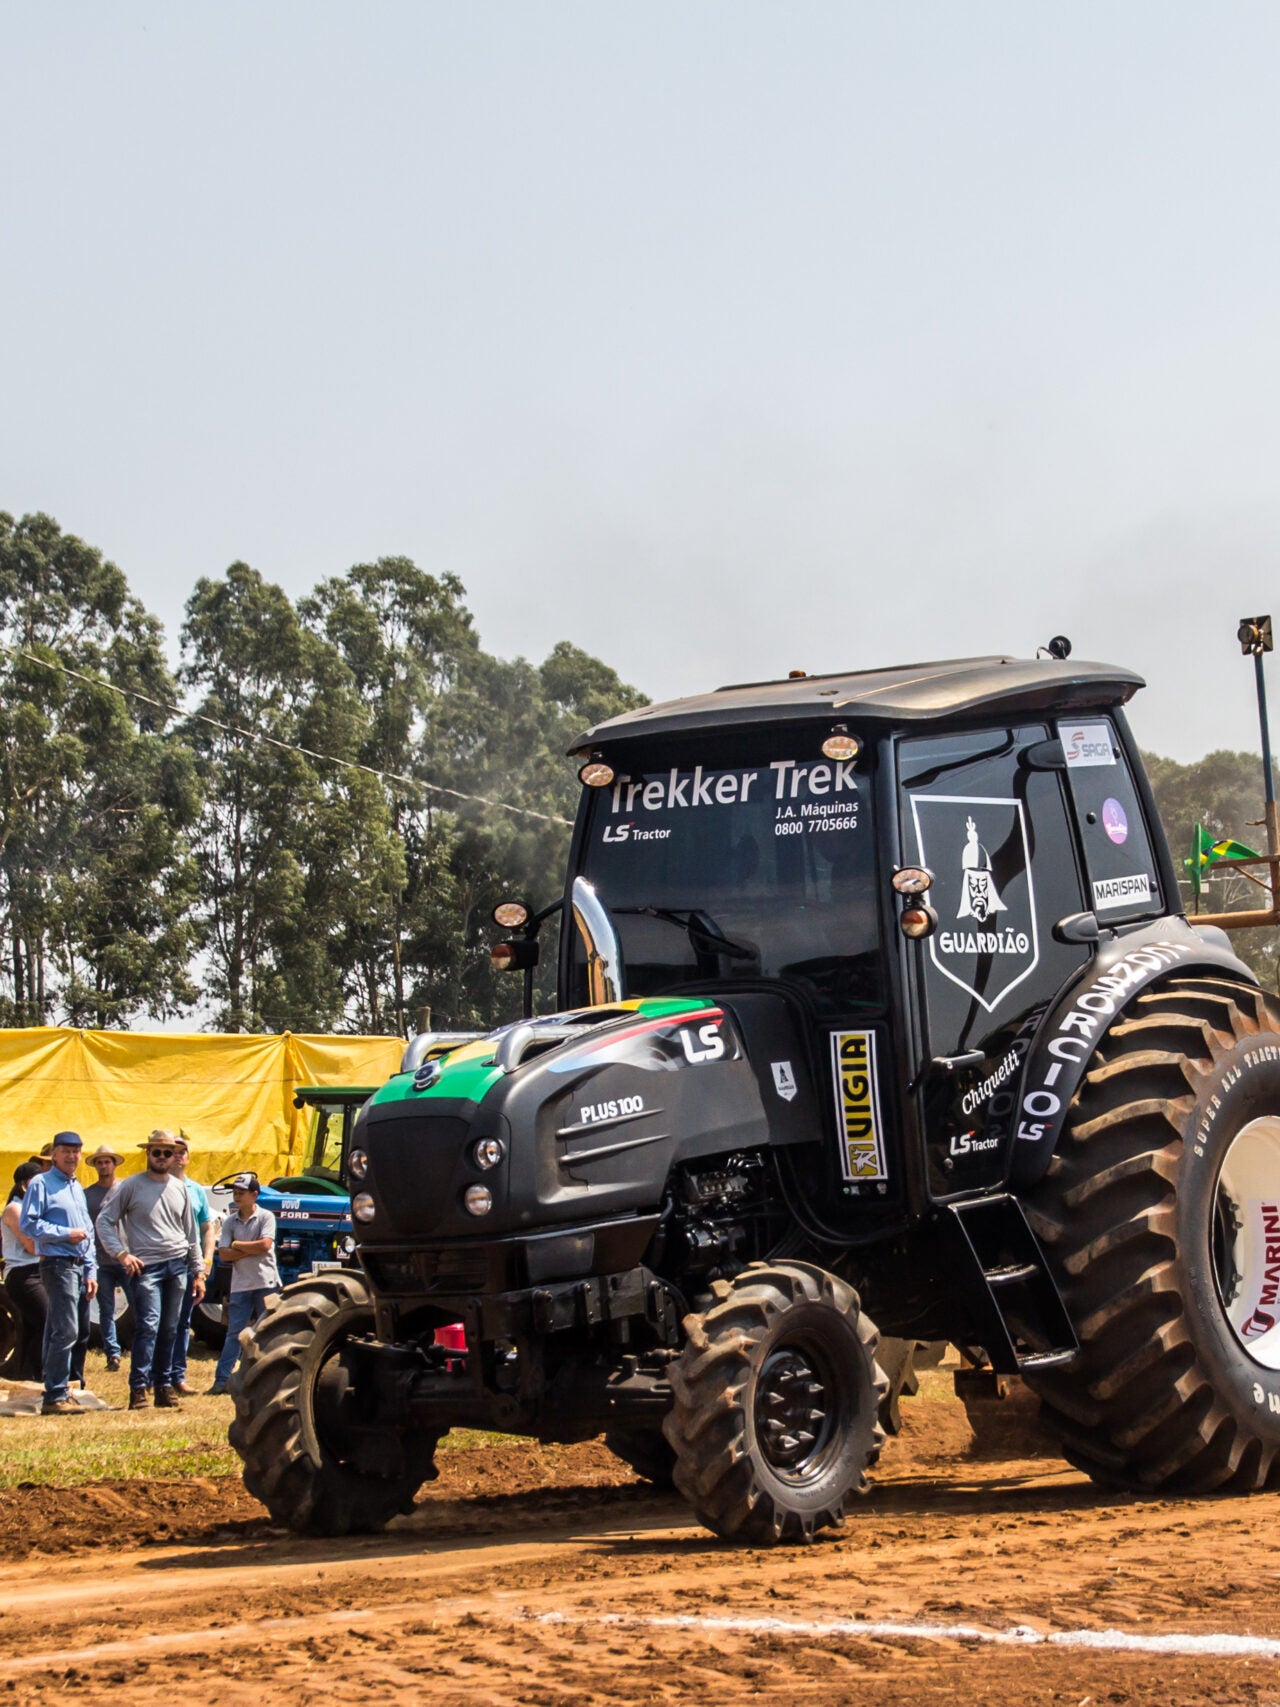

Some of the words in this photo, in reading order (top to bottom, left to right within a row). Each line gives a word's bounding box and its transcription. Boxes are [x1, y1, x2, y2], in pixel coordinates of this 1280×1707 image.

[611, 766, 757, 814] Trekker
[770, 760, 859, 799] Trek
[775, 806, 797, 820] J.A.
[800, 802, 859, 818] Máquinas
[602, 823, 632, 843] LS
[633, 827, 671, 841] Tractor
[775, 821, 803, 836] 0800
[808, 816, 857, 833] 7705666
[1096, 877, 1148, 900] MARISPAN
[940, 927, 1029, 954] GUARDIÃO
[679, 1021, 725, 1064] LS
[962, 1049, 1020, 1115] Chiquetti
[1193, 1094, 1222, 1158] SUPER
[1221, 1065, 1242, 1093] ALL
[1017, 1121, 1049, 1141] LS
[950, 1132, 974, 1156] LS
[971, 1138, 998, 1152] Tractor
